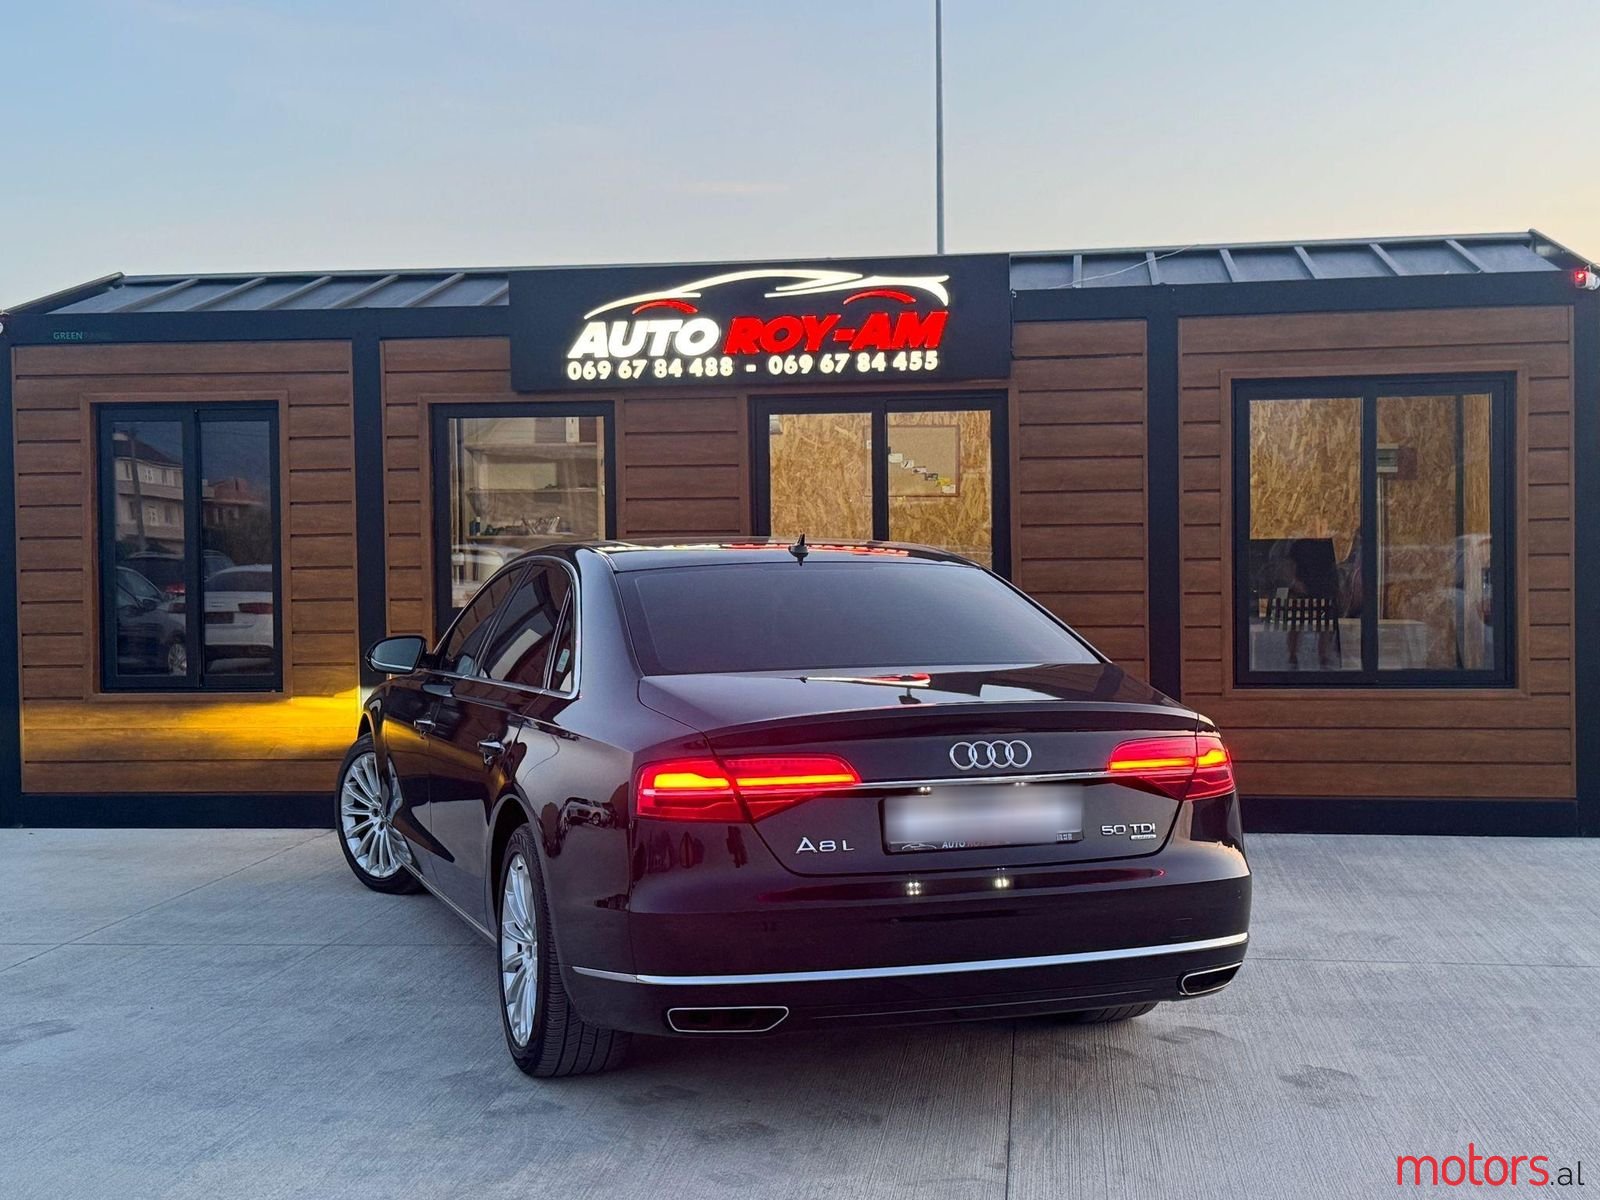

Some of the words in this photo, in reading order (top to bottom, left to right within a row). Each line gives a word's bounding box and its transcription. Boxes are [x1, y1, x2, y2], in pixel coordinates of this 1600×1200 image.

[53, 331, 83, 340] GREEN
[567, 317, 720, 358] AUTO
[723, 311, 949, 355] ROY-AM
[567, 361, 612, 381] 069
[617, 359, 648, 380] 67
[653, 358, 683, 379] 84
[688, 356, 733, 378] 488
[768, 354, 813, 376] 069
[819, 353, 851, 374] 67
[856, 352, 887, 373] 84
[892, 350, 938, 372] 455
[1101, 824, 1127, 835] 50
[1129, 822, 1157, 834] TDI
[795, 836, 837, 854] A8
[842, 839, 855, 851] L
[941, 840, 966, 849] AUTO
